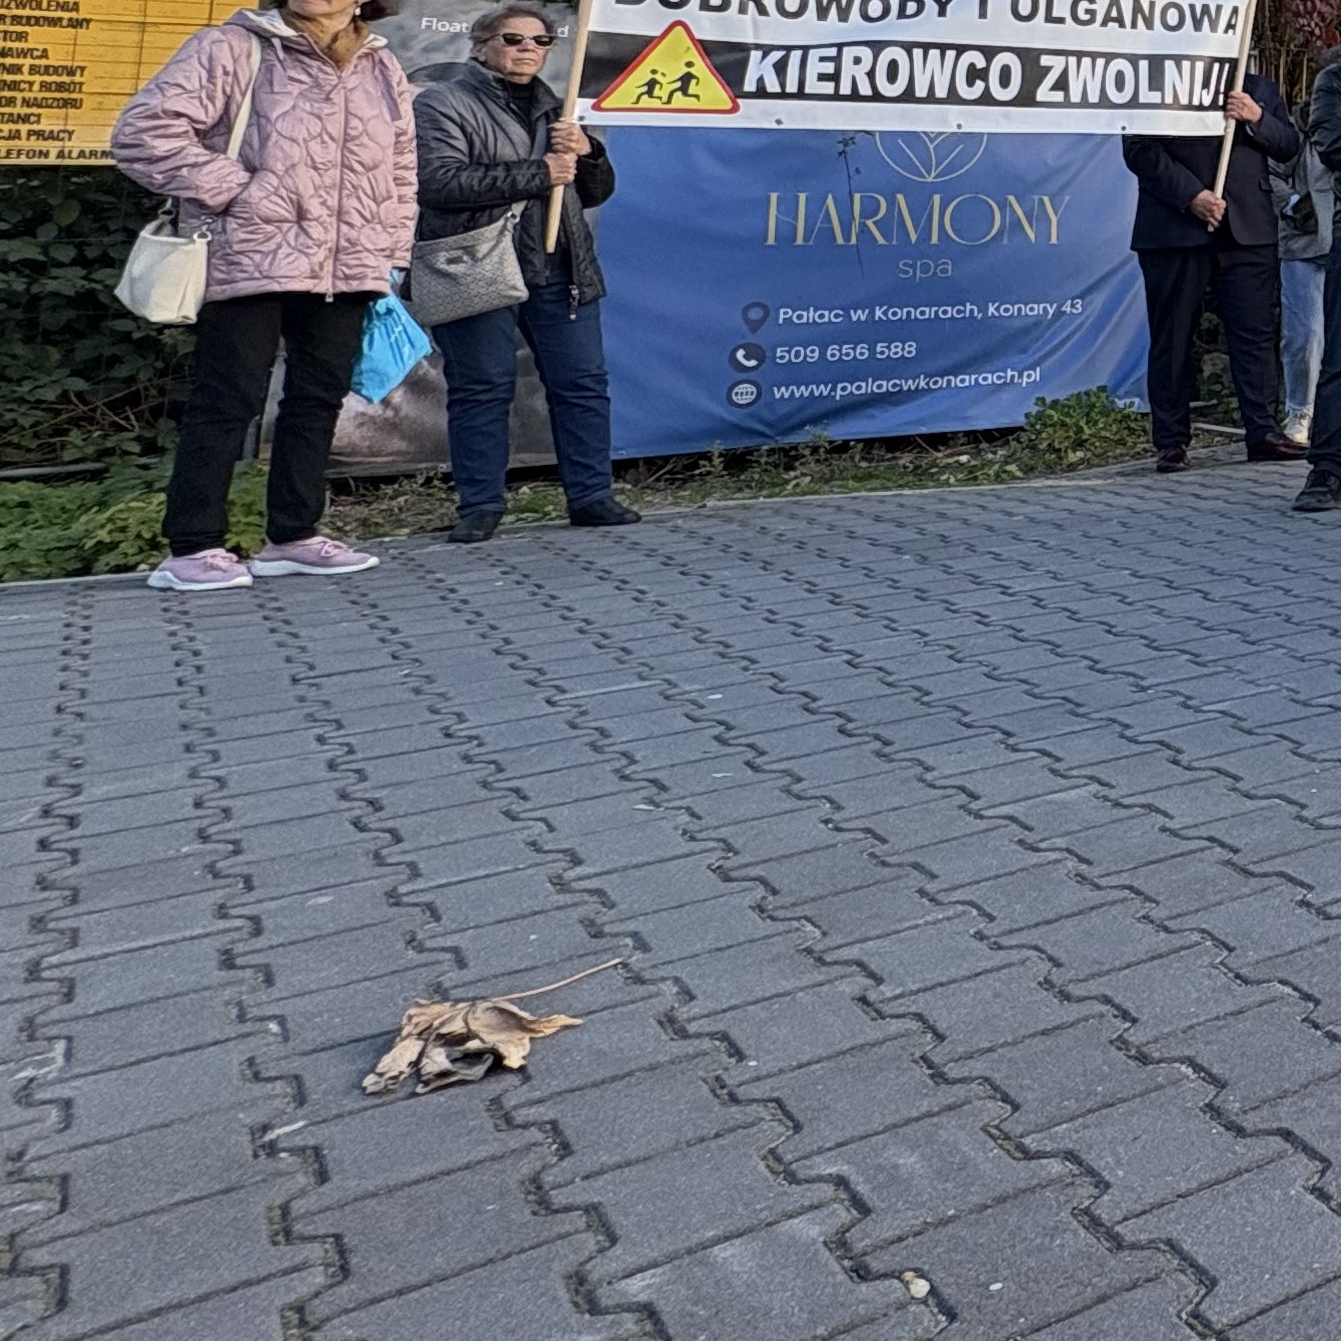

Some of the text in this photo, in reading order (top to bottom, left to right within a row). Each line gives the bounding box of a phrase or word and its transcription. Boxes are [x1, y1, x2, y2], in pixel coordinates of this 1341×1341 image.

[743, 46, 1230, 107] KIEROWCO ZWOLNIJ!
[27, 130, 76, 142] PRACY
[56, 150, 115, 160] ALARM
[763, 192, 1070, 246] HARMONY
[898, 258, 953, 282] spa
[778, 299, 1083, 325] Pałac w Konarach, Konary 43
[775, 341, 917, 364] 509 656 588
[773, 366, 1041, 400] www.palacwkonarach.pl
